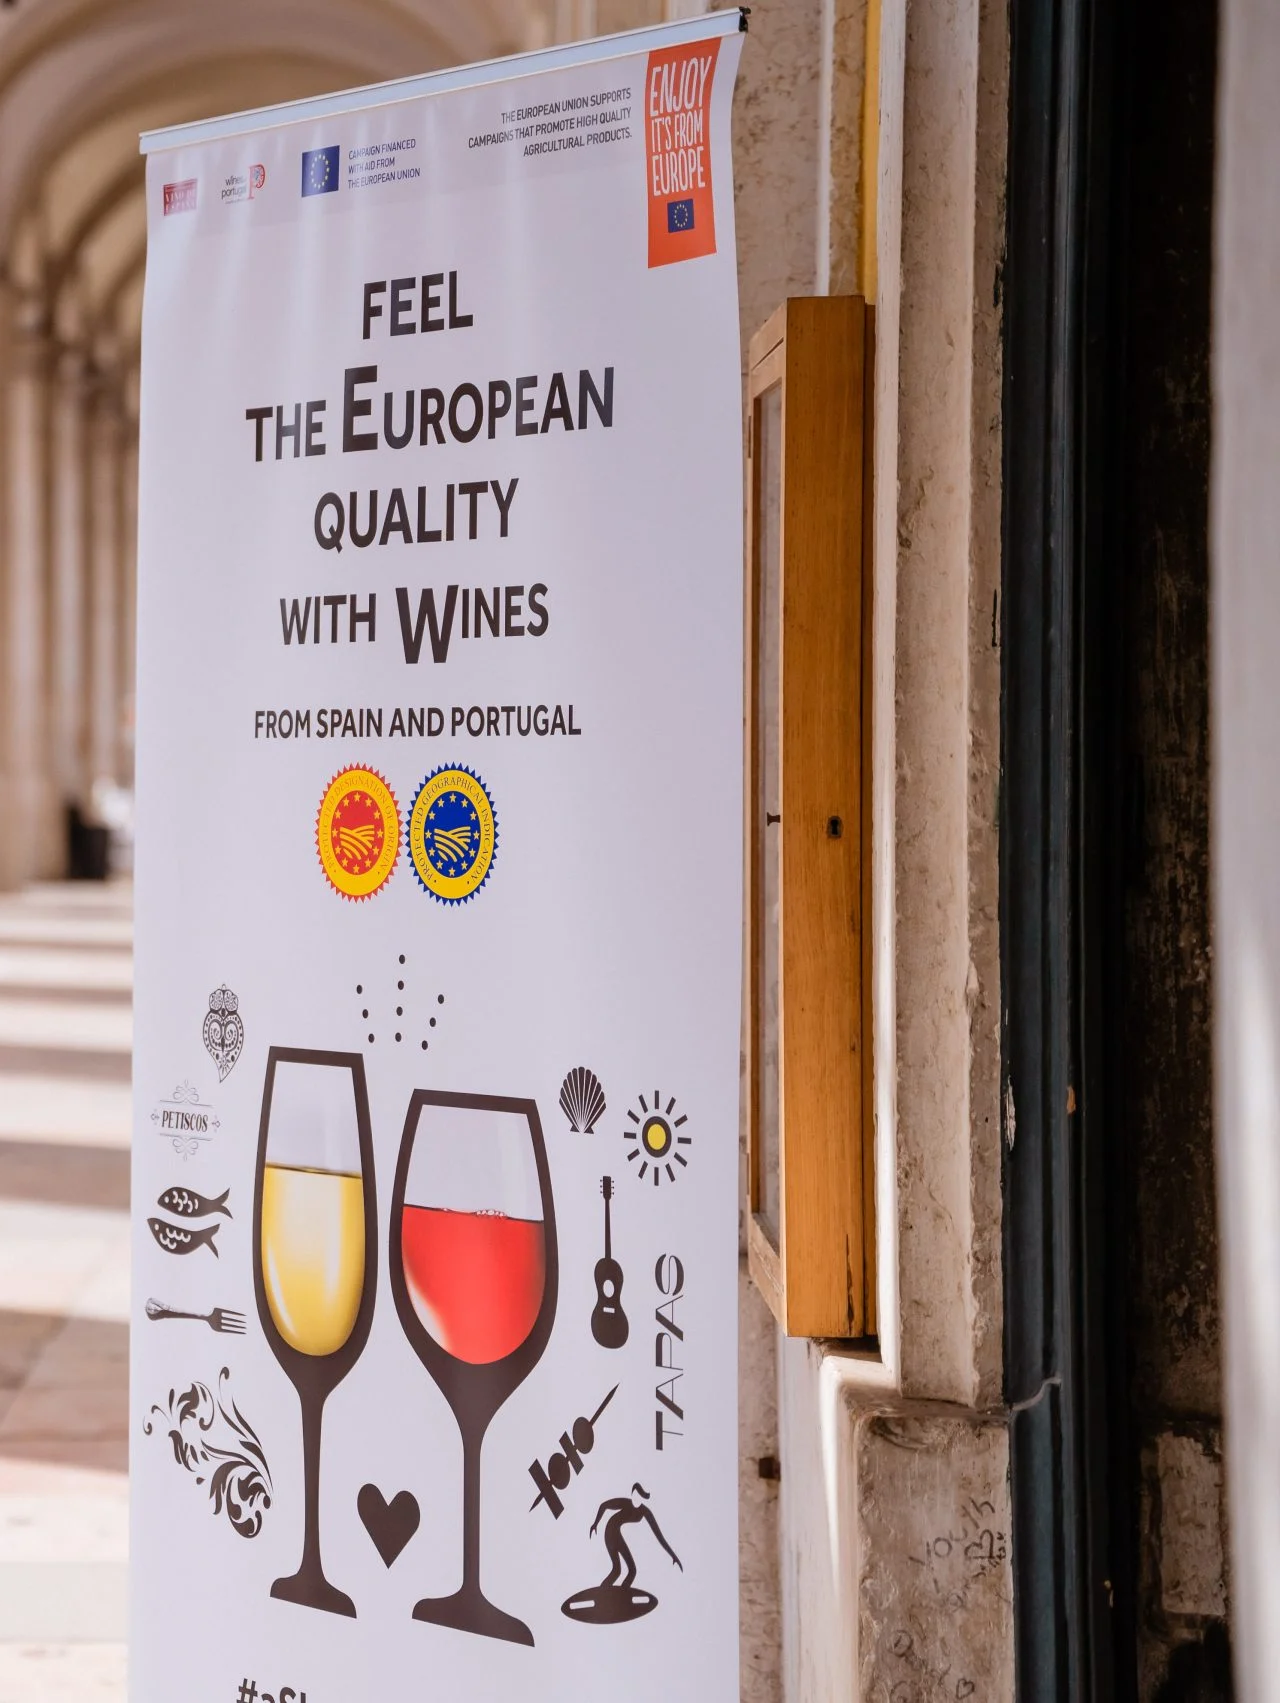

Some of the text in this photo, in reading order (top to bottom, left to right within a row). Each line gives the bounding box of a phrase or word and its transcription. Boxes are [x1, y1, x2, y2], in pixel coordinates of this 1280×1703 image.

[501, 87, 632, 124] THE EUROPEAN UNION SUPPORTS
[649, 55, 713, 117] ENJOY
[348, 138, 416, 160] CAMPAIGN FINANCED
[468, 106, 632, 149] CAMPAIGNS THAT PROMOTE HIGH QUALITY
[523, 127, 633, 157] AGRICULTURAL PRODUCTS.
[651, 109, 704, 154] IT'S FROM
[348, 157, 396, 175] WITH AID FROM
[348, 167, 421, 189] THE EUROPEAN UNION
[651, 146, 706, 197] EUROPE
[362, 270, 474, 340] FEEL
[245, 364, 615, 463] THE EUROPEAN
[313, 477, 520, 554] QUALITY
[279, 582, 550, 665] WITH WINES
[254, 704, 582, 739] FROM SPAIN AND PORTUGAL
[413, 776, 491, 883] PROTECTED GEOGRAPHICAL INDICATION
[161, 1110, 209, 1132] PETISCOS
[654, 1253, 685, 1452] TAPAS
